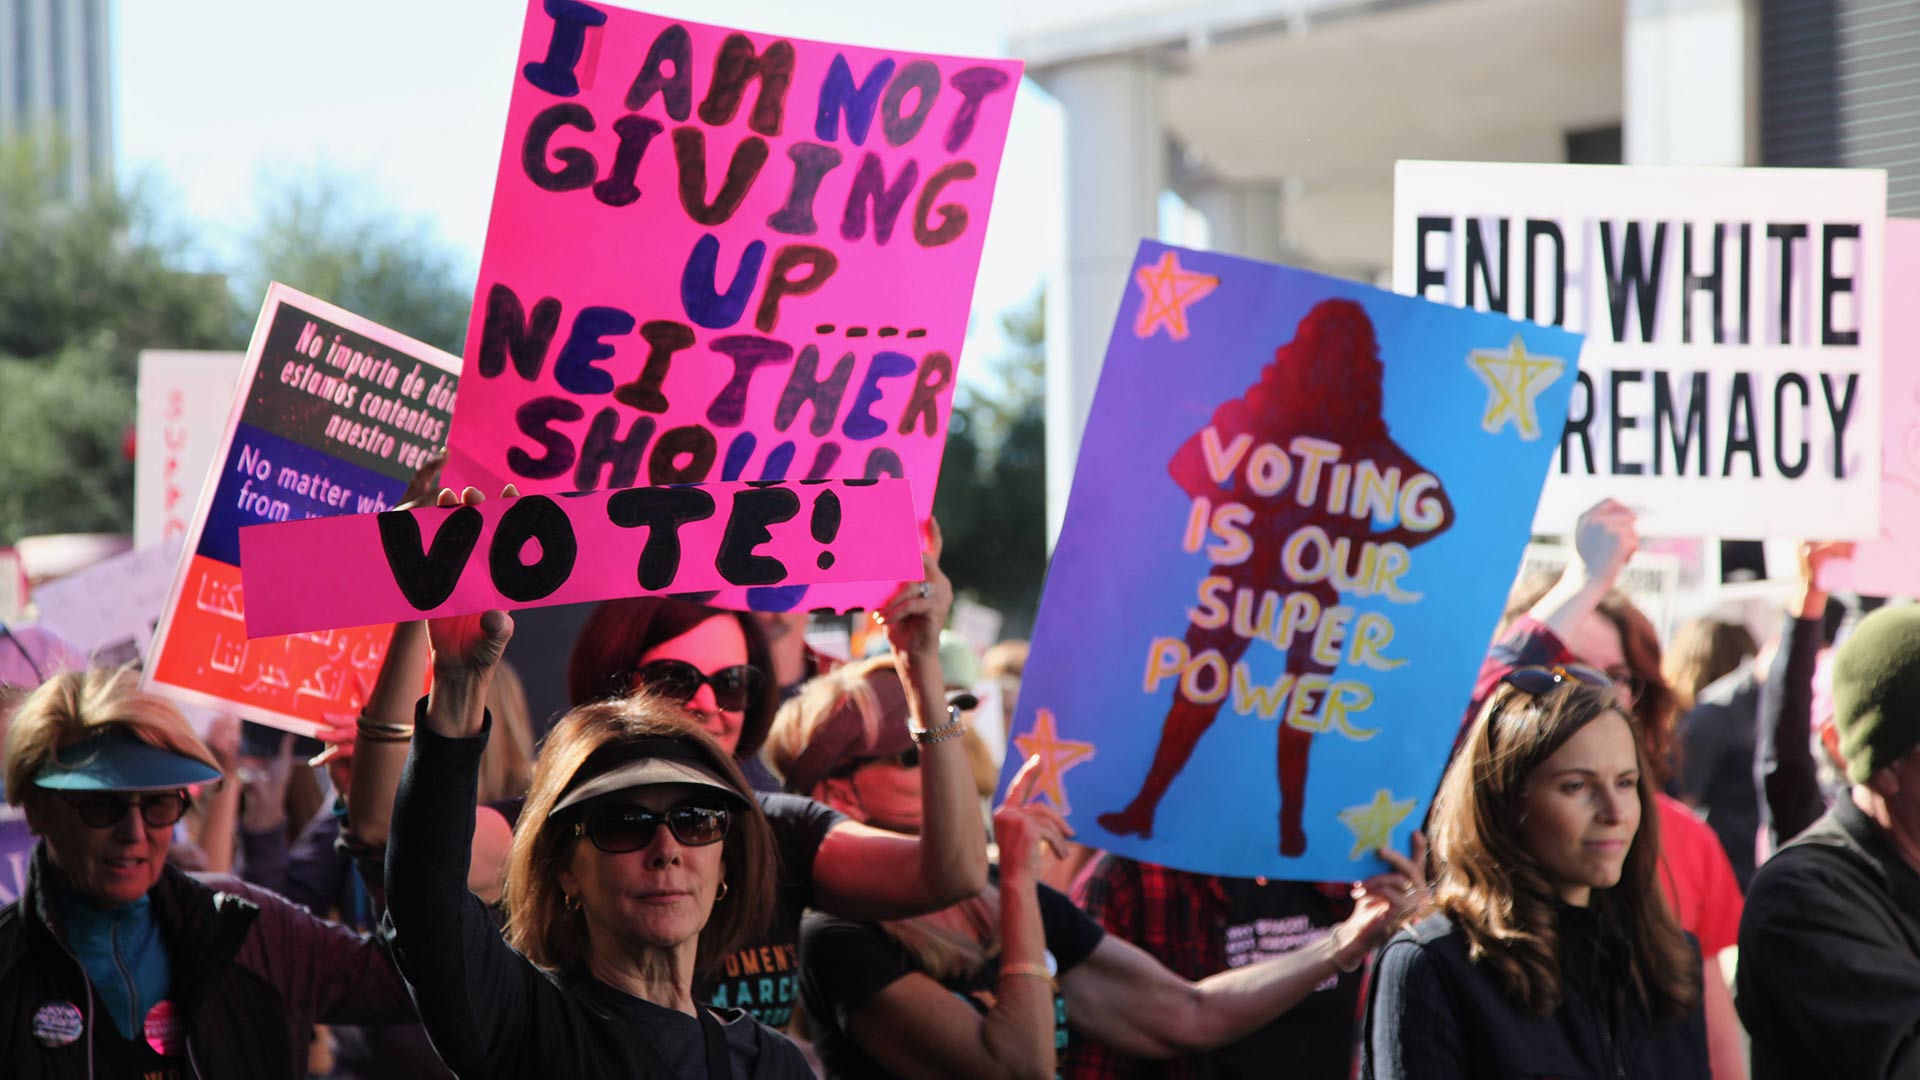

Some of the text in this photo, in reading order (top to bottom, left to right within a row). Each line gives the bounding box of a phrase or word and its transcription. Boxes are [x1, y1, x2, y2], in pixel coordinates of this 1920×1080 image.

[523, 0, 1011, 154] I AM NOT
[521, 102, 977, 248] GIVING
[680, 233, 838, 334] UP
[1416, 217, 1863, 347] END WHITE
[280, 360, 445, 443] estamos contentos
[295, 320, 458, 416] No importa de dón
[478, 283, 953, 440] NEITHER
[236, 443, 272, 481] No
[277, 466, 353, 509] matter
[325, 414, 396, 459] nuestro
[1560, 370, 1860, 481] REMACY
[237, 479, 290, 522] from
[1202, 426, 1446, 532] VOTING
[377, 486, 842, 612] VOTE!
[1181, 496, 1426, 604] IS OUR
[1186, 575, 1411, 672] SUPER
[1142, 636, 1383, 741] POWER
[724, 943, 799, 977] OMEN'S
